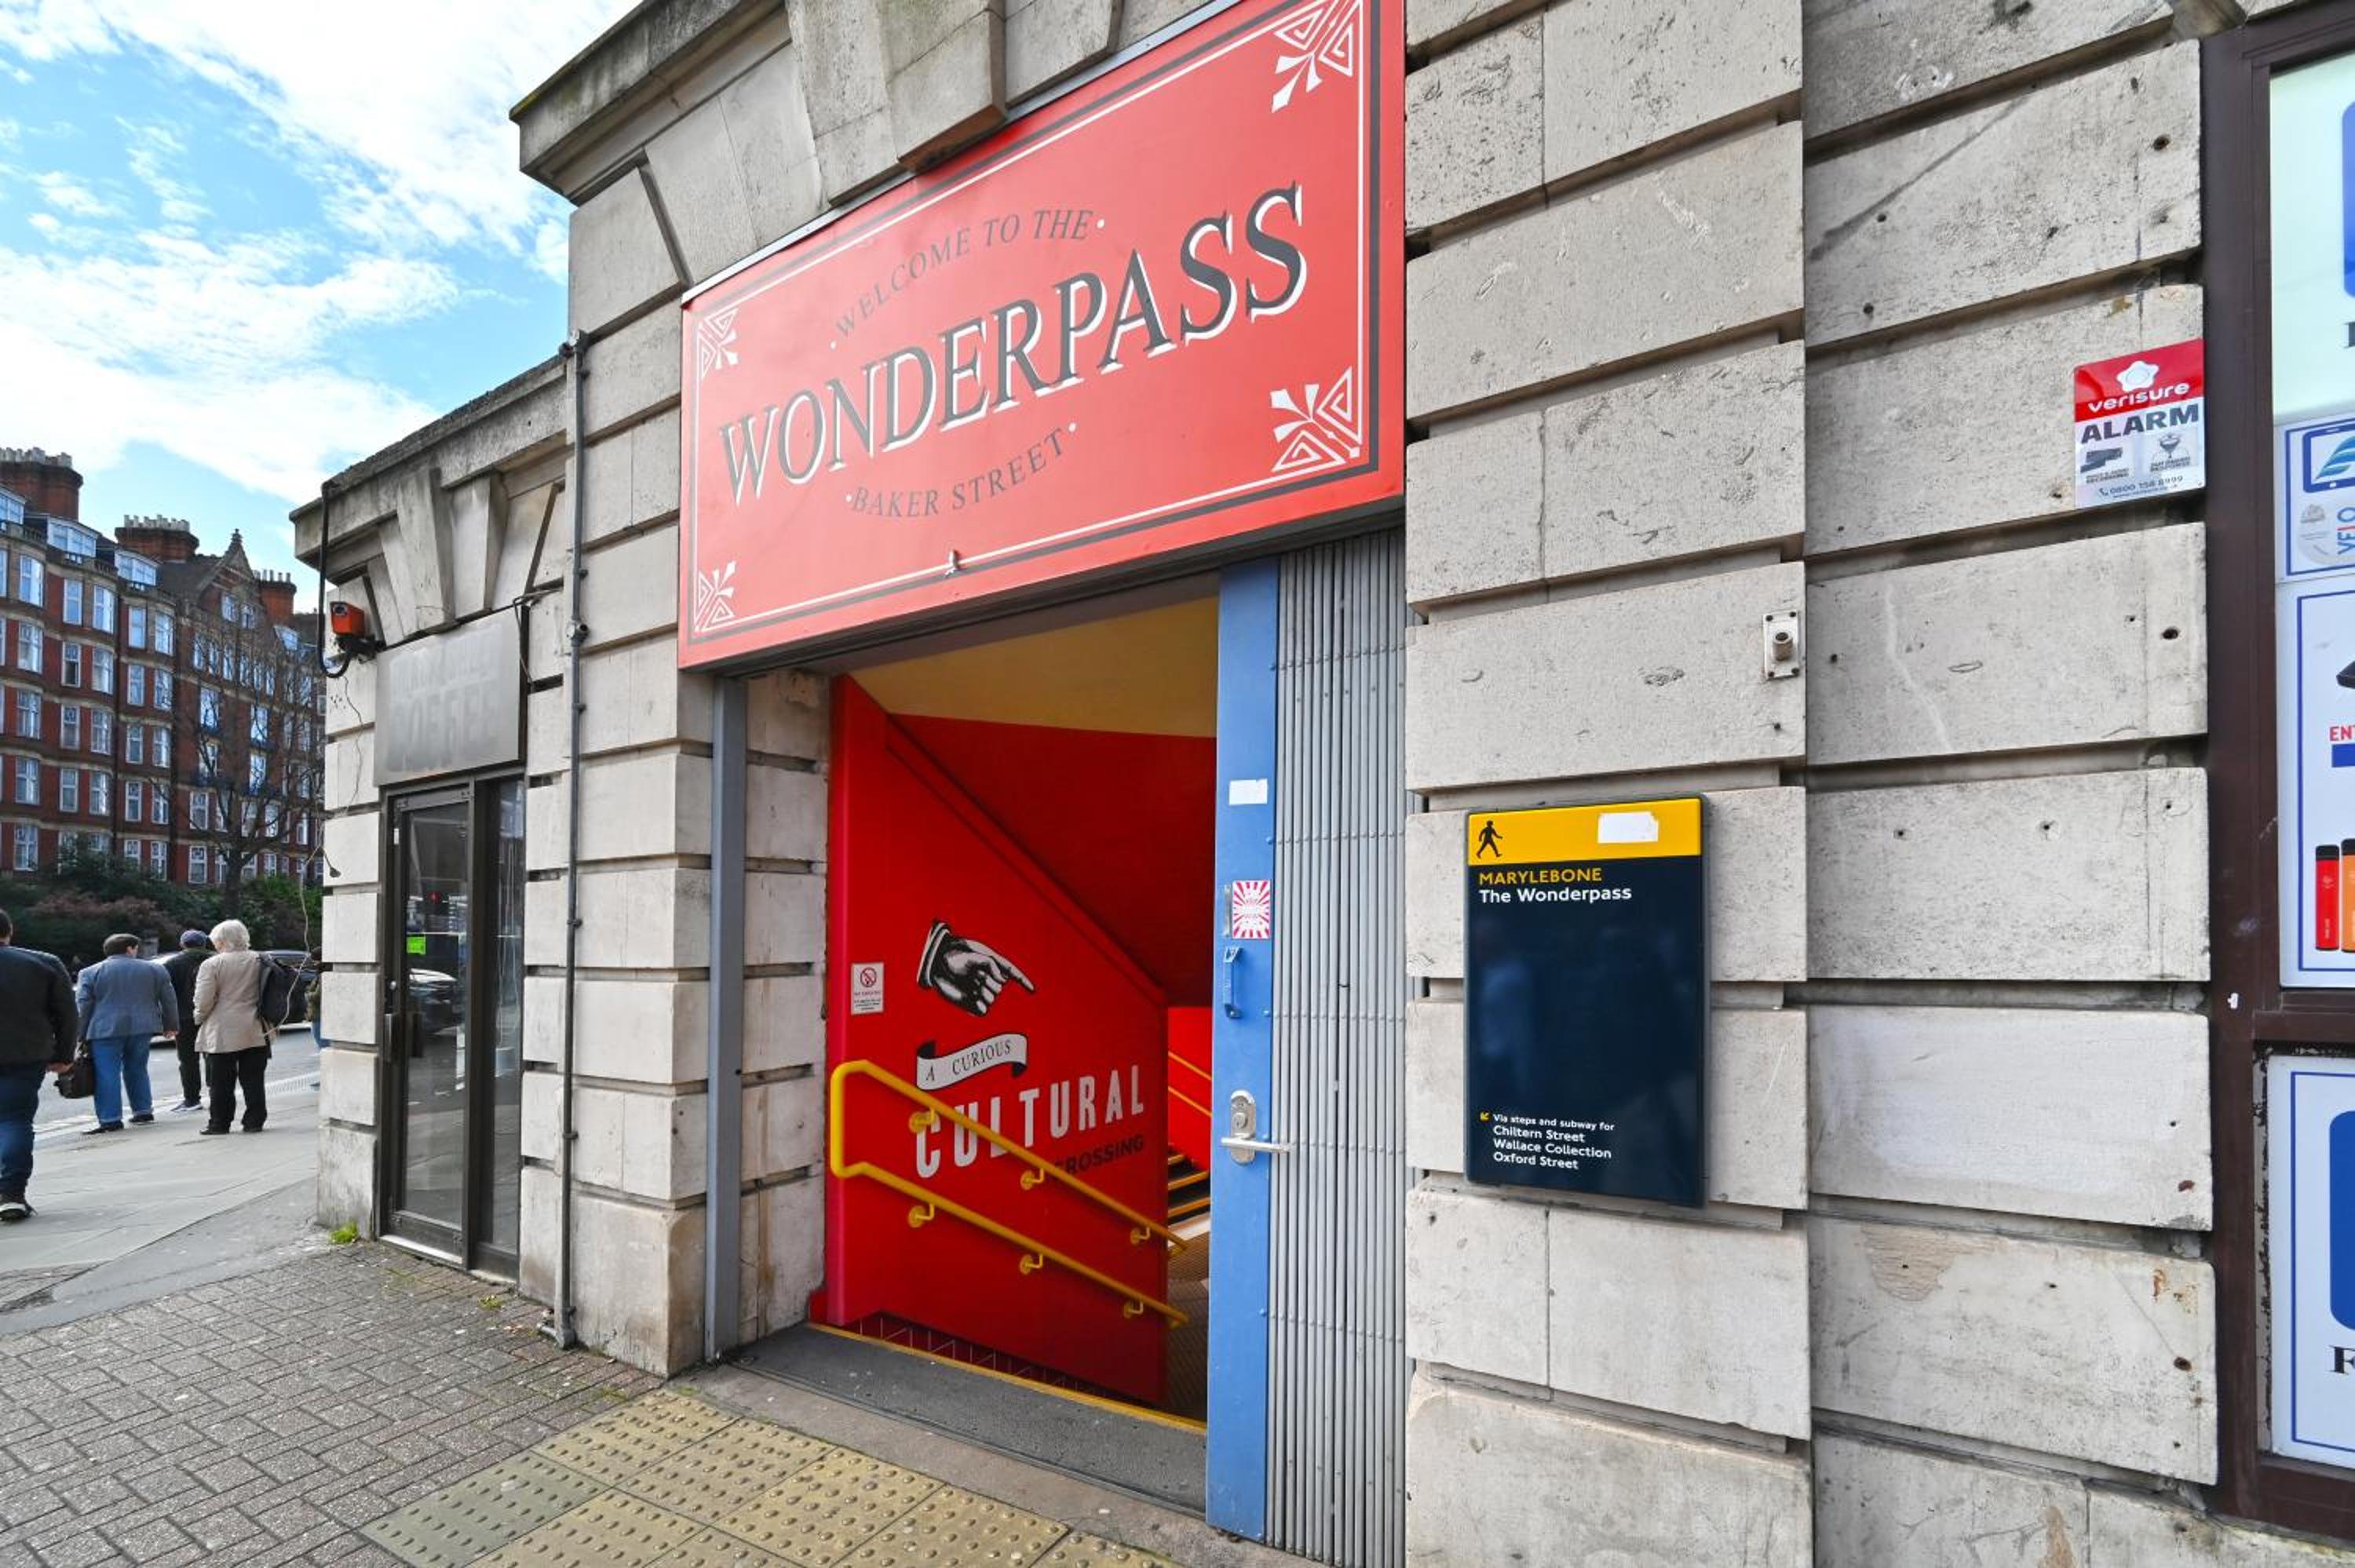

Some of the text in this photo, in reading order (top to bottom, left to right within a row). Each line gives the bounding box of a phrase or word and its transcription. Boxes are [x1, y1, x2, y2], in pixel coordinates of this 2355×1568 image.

[835, 210, 1094, 339] WELCOME TO THE
[718, 180, 1307, 506] WONDERPASS
[2087, 382, 2190, 413] verisure
[2081, 403, 2199, 444] ALARM
[853, 426, 1063, 518] BAKER STREET
[2329, 724, 2355, 742] EN
[1479, 867, 1602, 885] MARYLEBONE
[1479, 887, 1632, 904] The Wonderpass
[925, 1039, 1012, 1082] A CURIOUS
[916, 1064, 1145, 1178] CULTURAL
[1493, 1114, 1615, 1131] Via steps and subway for
[1493, 1125, 1586, 1143] Chiltern Street
[1493, 1138, 1612, 1158] Wallace Collection
[1493, 1151, 1579, 1170] Oxford Street
